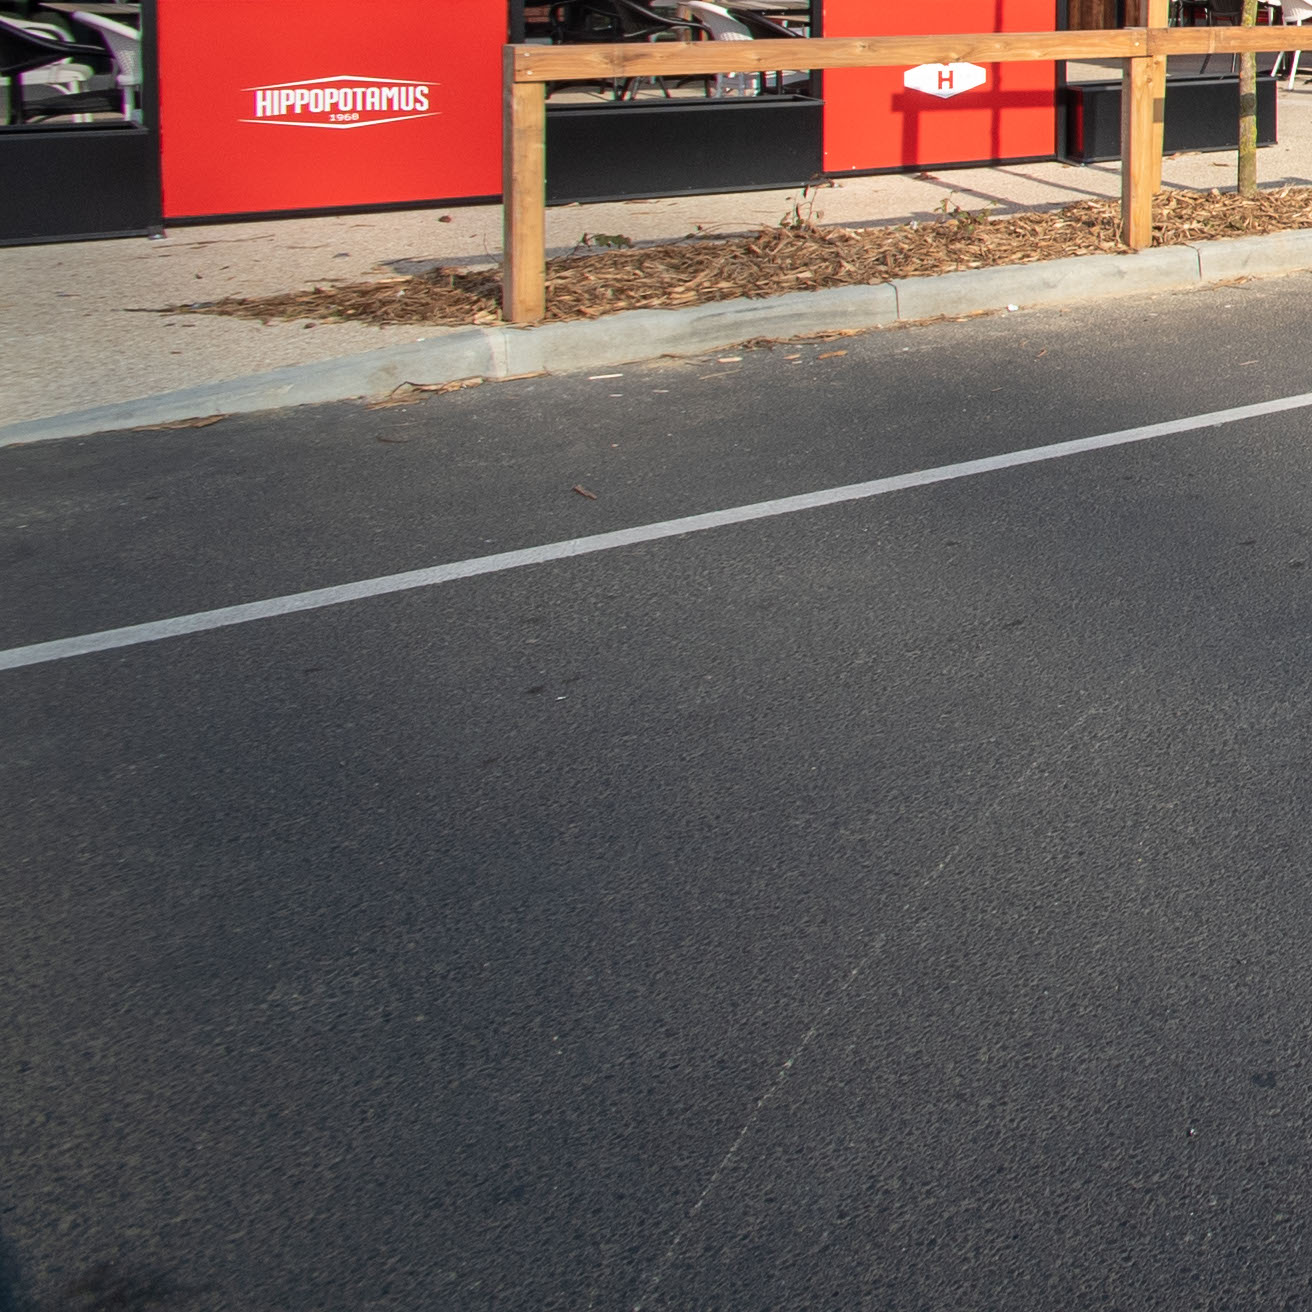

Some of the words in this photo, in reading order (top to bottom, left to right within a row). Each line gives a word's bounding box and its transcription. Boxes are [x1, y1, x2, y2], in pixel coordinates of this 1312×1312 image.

[938, 71, 953, 89] H
[254, 85, 430, 117] HIPPOPOTAMUS
[329, 112, 360, 122] 1968
